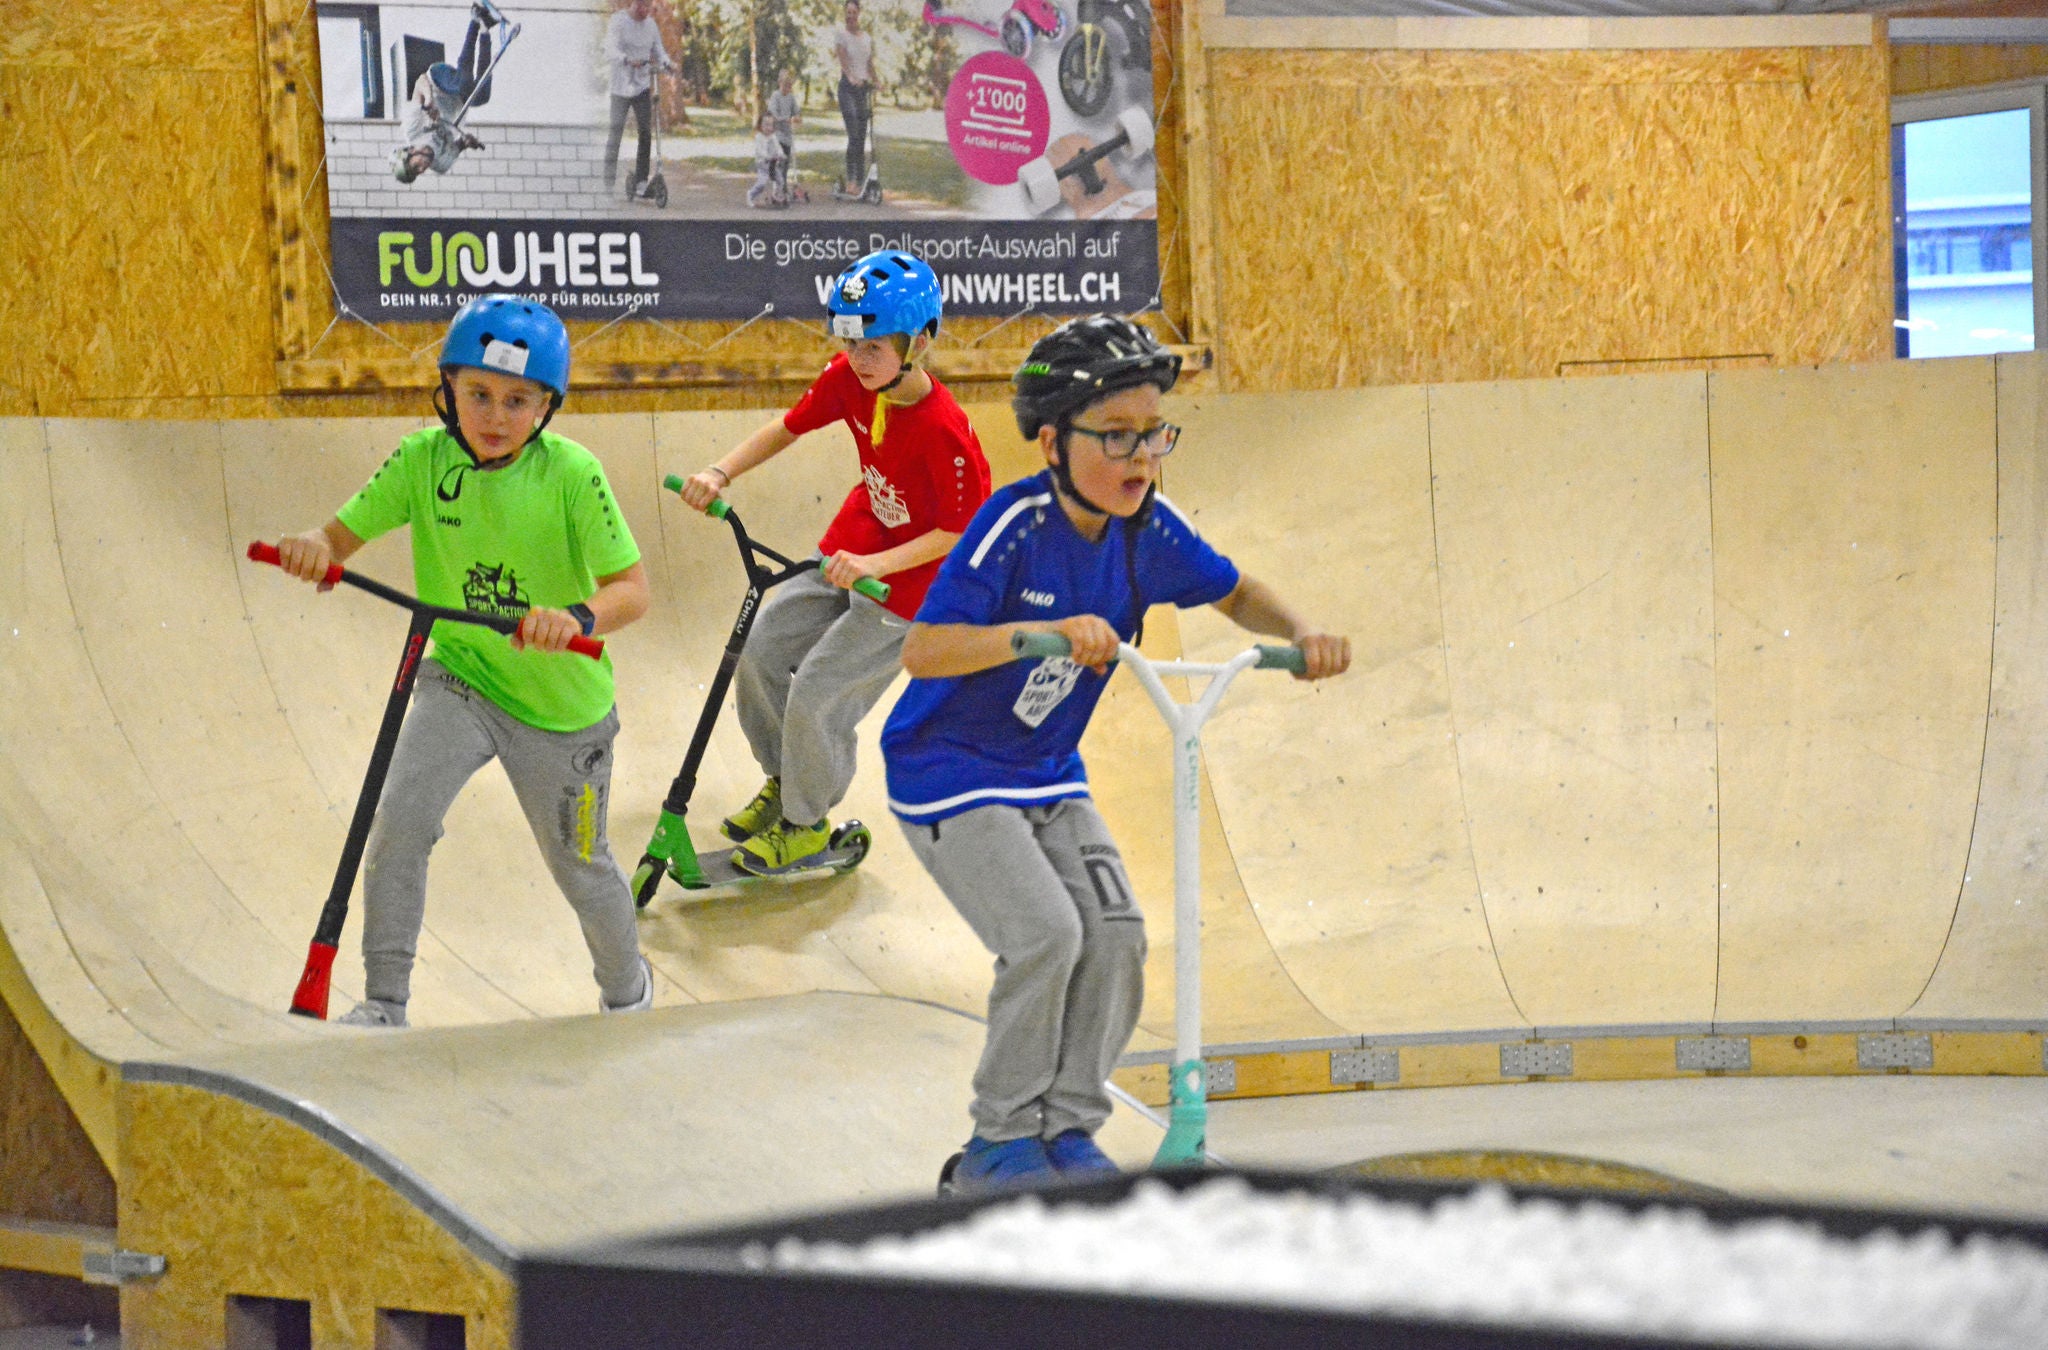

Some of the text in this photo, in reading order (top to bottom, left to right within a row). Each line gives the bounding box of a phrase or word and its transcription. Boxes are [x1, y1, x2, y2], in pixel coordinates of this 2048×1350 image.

[966, 86, 1027, 113] +1'000
[963, 133, 1031, 154] Artikel online
[378, 231, 660, 288] FUNWHEEL
[725, 231, 1120, 264] Die grösste Rollsport-Auswahl auf
[380, 293, 414, 306] DEIN
[420, 293, 451, 306] NR.1
[552, 290, 578, 305] FÜR
[582, 292, 660, 306] ROLLSPORT
[815, 273, 1120, 305] WNWHEEL.CH
[438, 514, 461, 527] JAKO
[1020, 588, 1055, 607] JAKO
